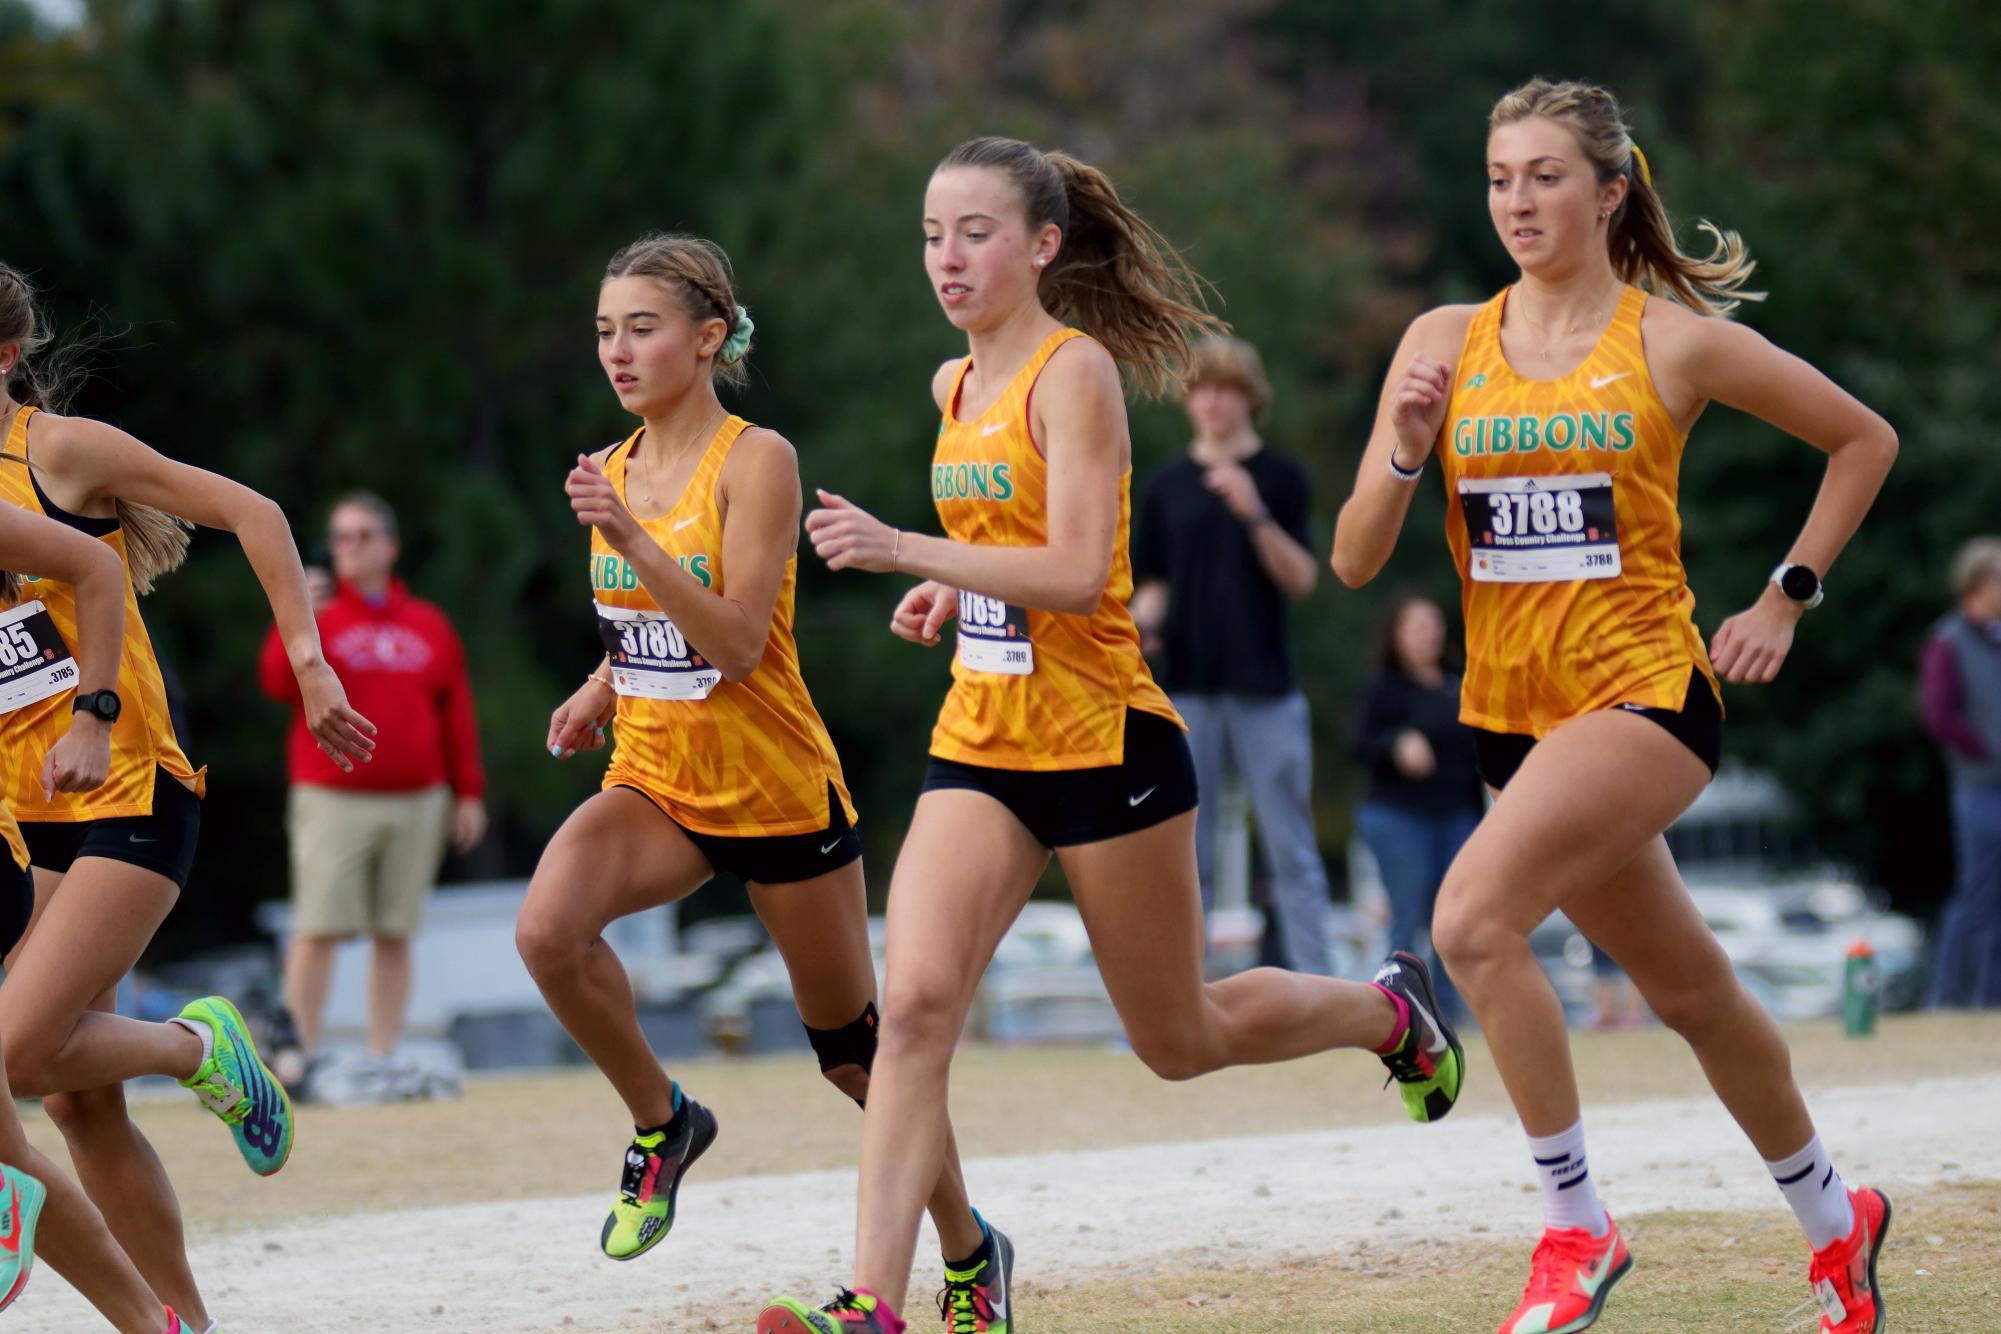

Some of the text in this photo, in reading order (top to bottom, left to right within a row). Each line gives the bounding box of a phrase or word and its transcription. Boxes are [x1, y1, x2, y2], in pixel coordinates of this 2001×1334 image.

[1455, 411, 1636, 457] GIBBONS
[931, 463, 1014, 502] BBONS
[1488, 490, 1585, 536] 3788
[1495, 533, 1586, 545] Cross Country Challenge
[590, 553, 713, 591] IBBS
[1586, 554, 1613, 566] 3788
[0, 621, 39, 667] 85
[613, 621, 688, 659] 3780
[13, 656, 45, 674] Challenge
[51, 665, 75, 683] 3785
